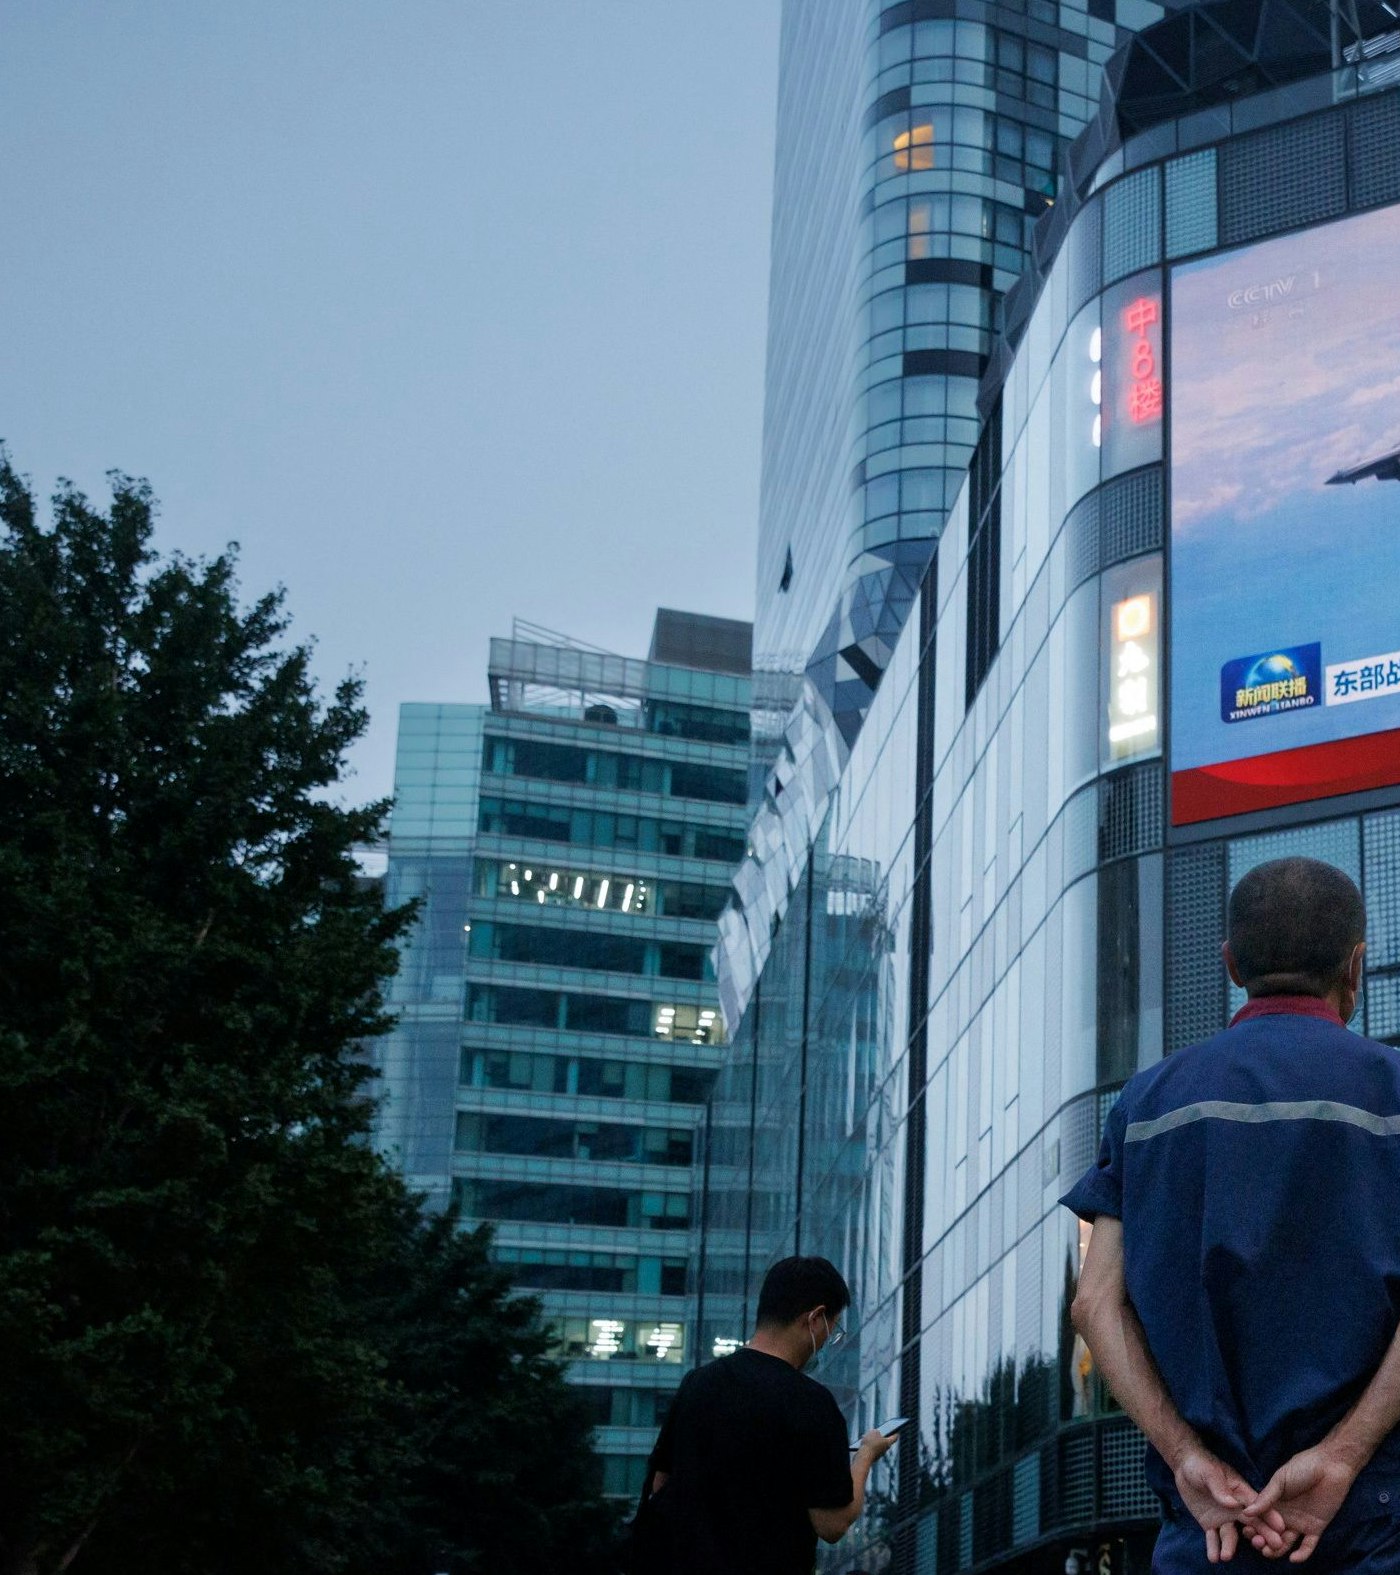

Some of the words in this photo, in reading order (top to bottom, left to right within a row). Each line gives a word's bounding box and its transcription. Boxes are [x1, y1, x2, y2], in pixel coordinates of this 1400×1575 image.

[1235, 675, 1307, 708] 新闻联播
[1229, 703, 1270, 720] XINWEN
